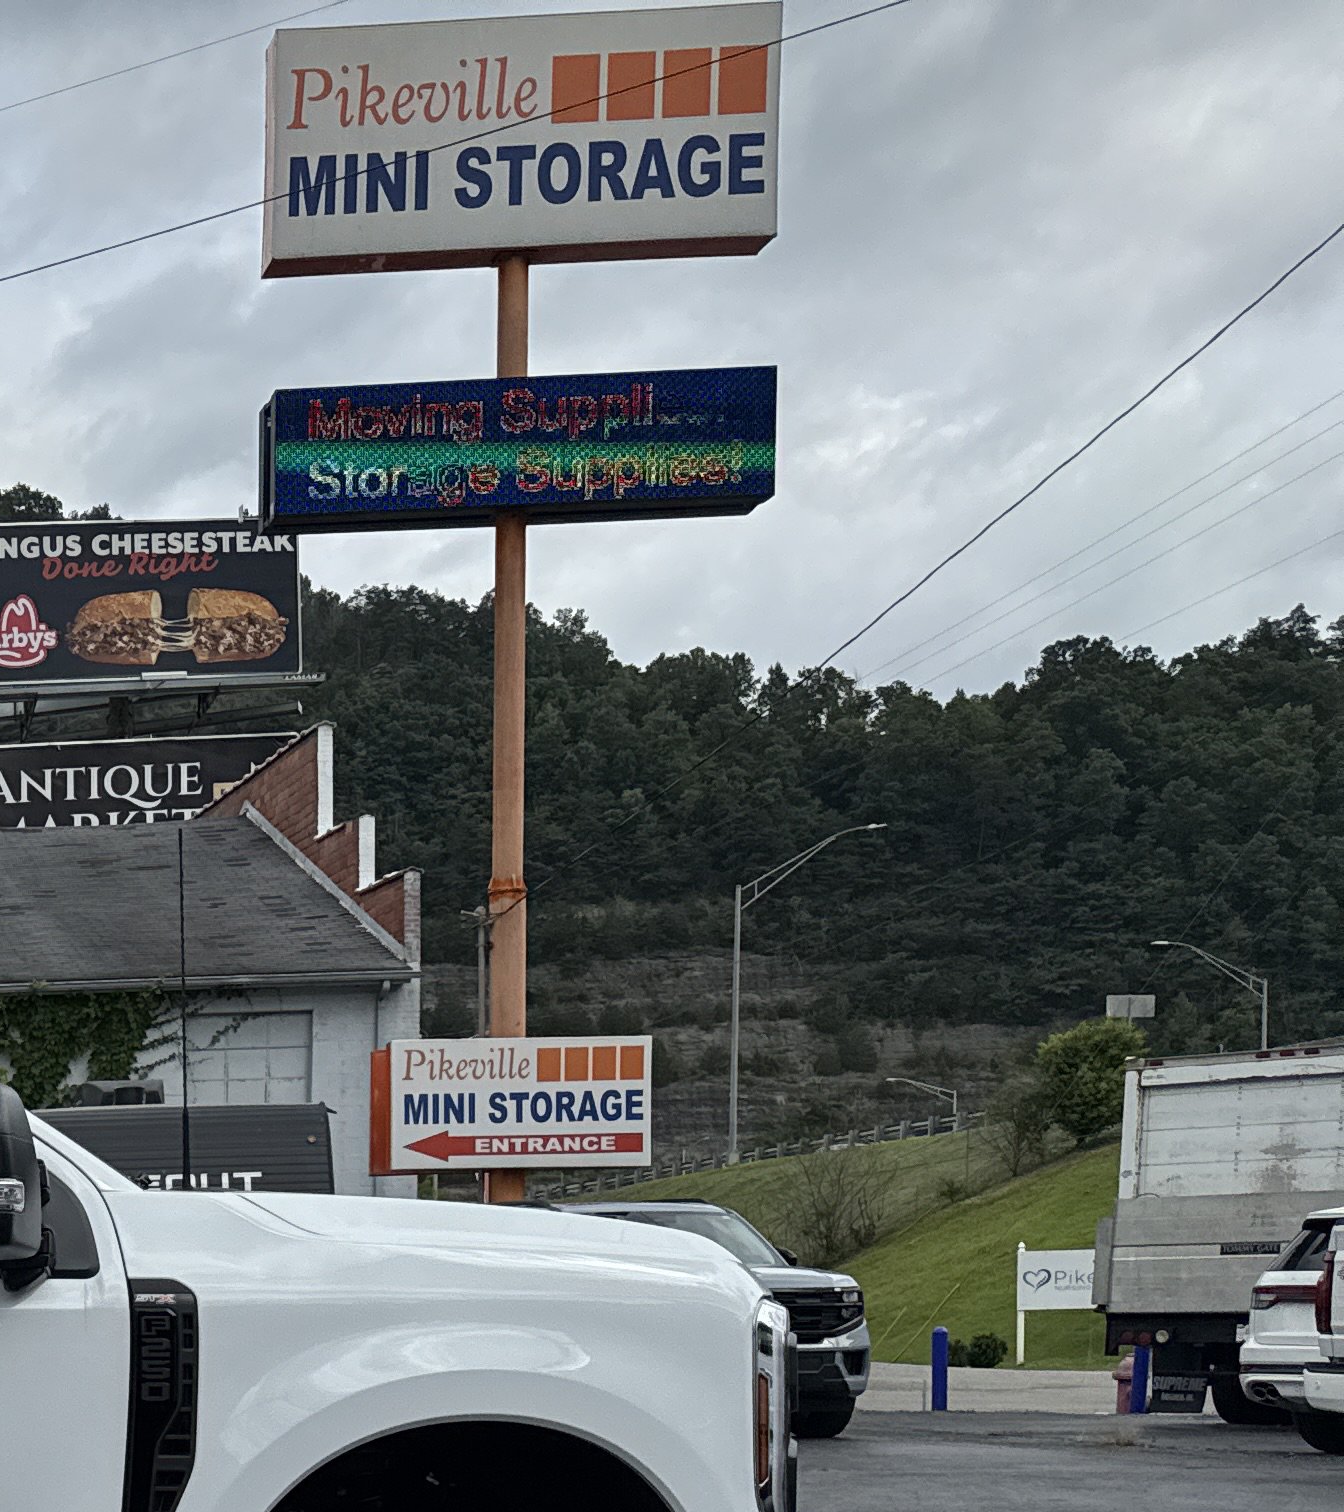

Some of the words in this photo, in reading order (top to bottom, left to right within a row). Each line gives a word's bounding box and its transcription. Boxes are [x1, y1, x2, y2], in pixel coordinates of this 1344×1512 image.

[286, 56, 538, 130] Pikeville
[288, 150, 429, 217] MINI
[454, 132, 765, 210] STORAGE
[308, 393, 484, 444] Moving
[92, 532, 294, 556] CHEESESTEAK
[42, 557, 123, 581] Done
[128, 552, 219, 581] Right
[402, 1047, 530, 1081] Pikeville
[404, 1092, 476, 1125] MINI
[488, 1089, 644, 1124] STORAGE
[474, 1135, 616, 1153] ENTRANCE
